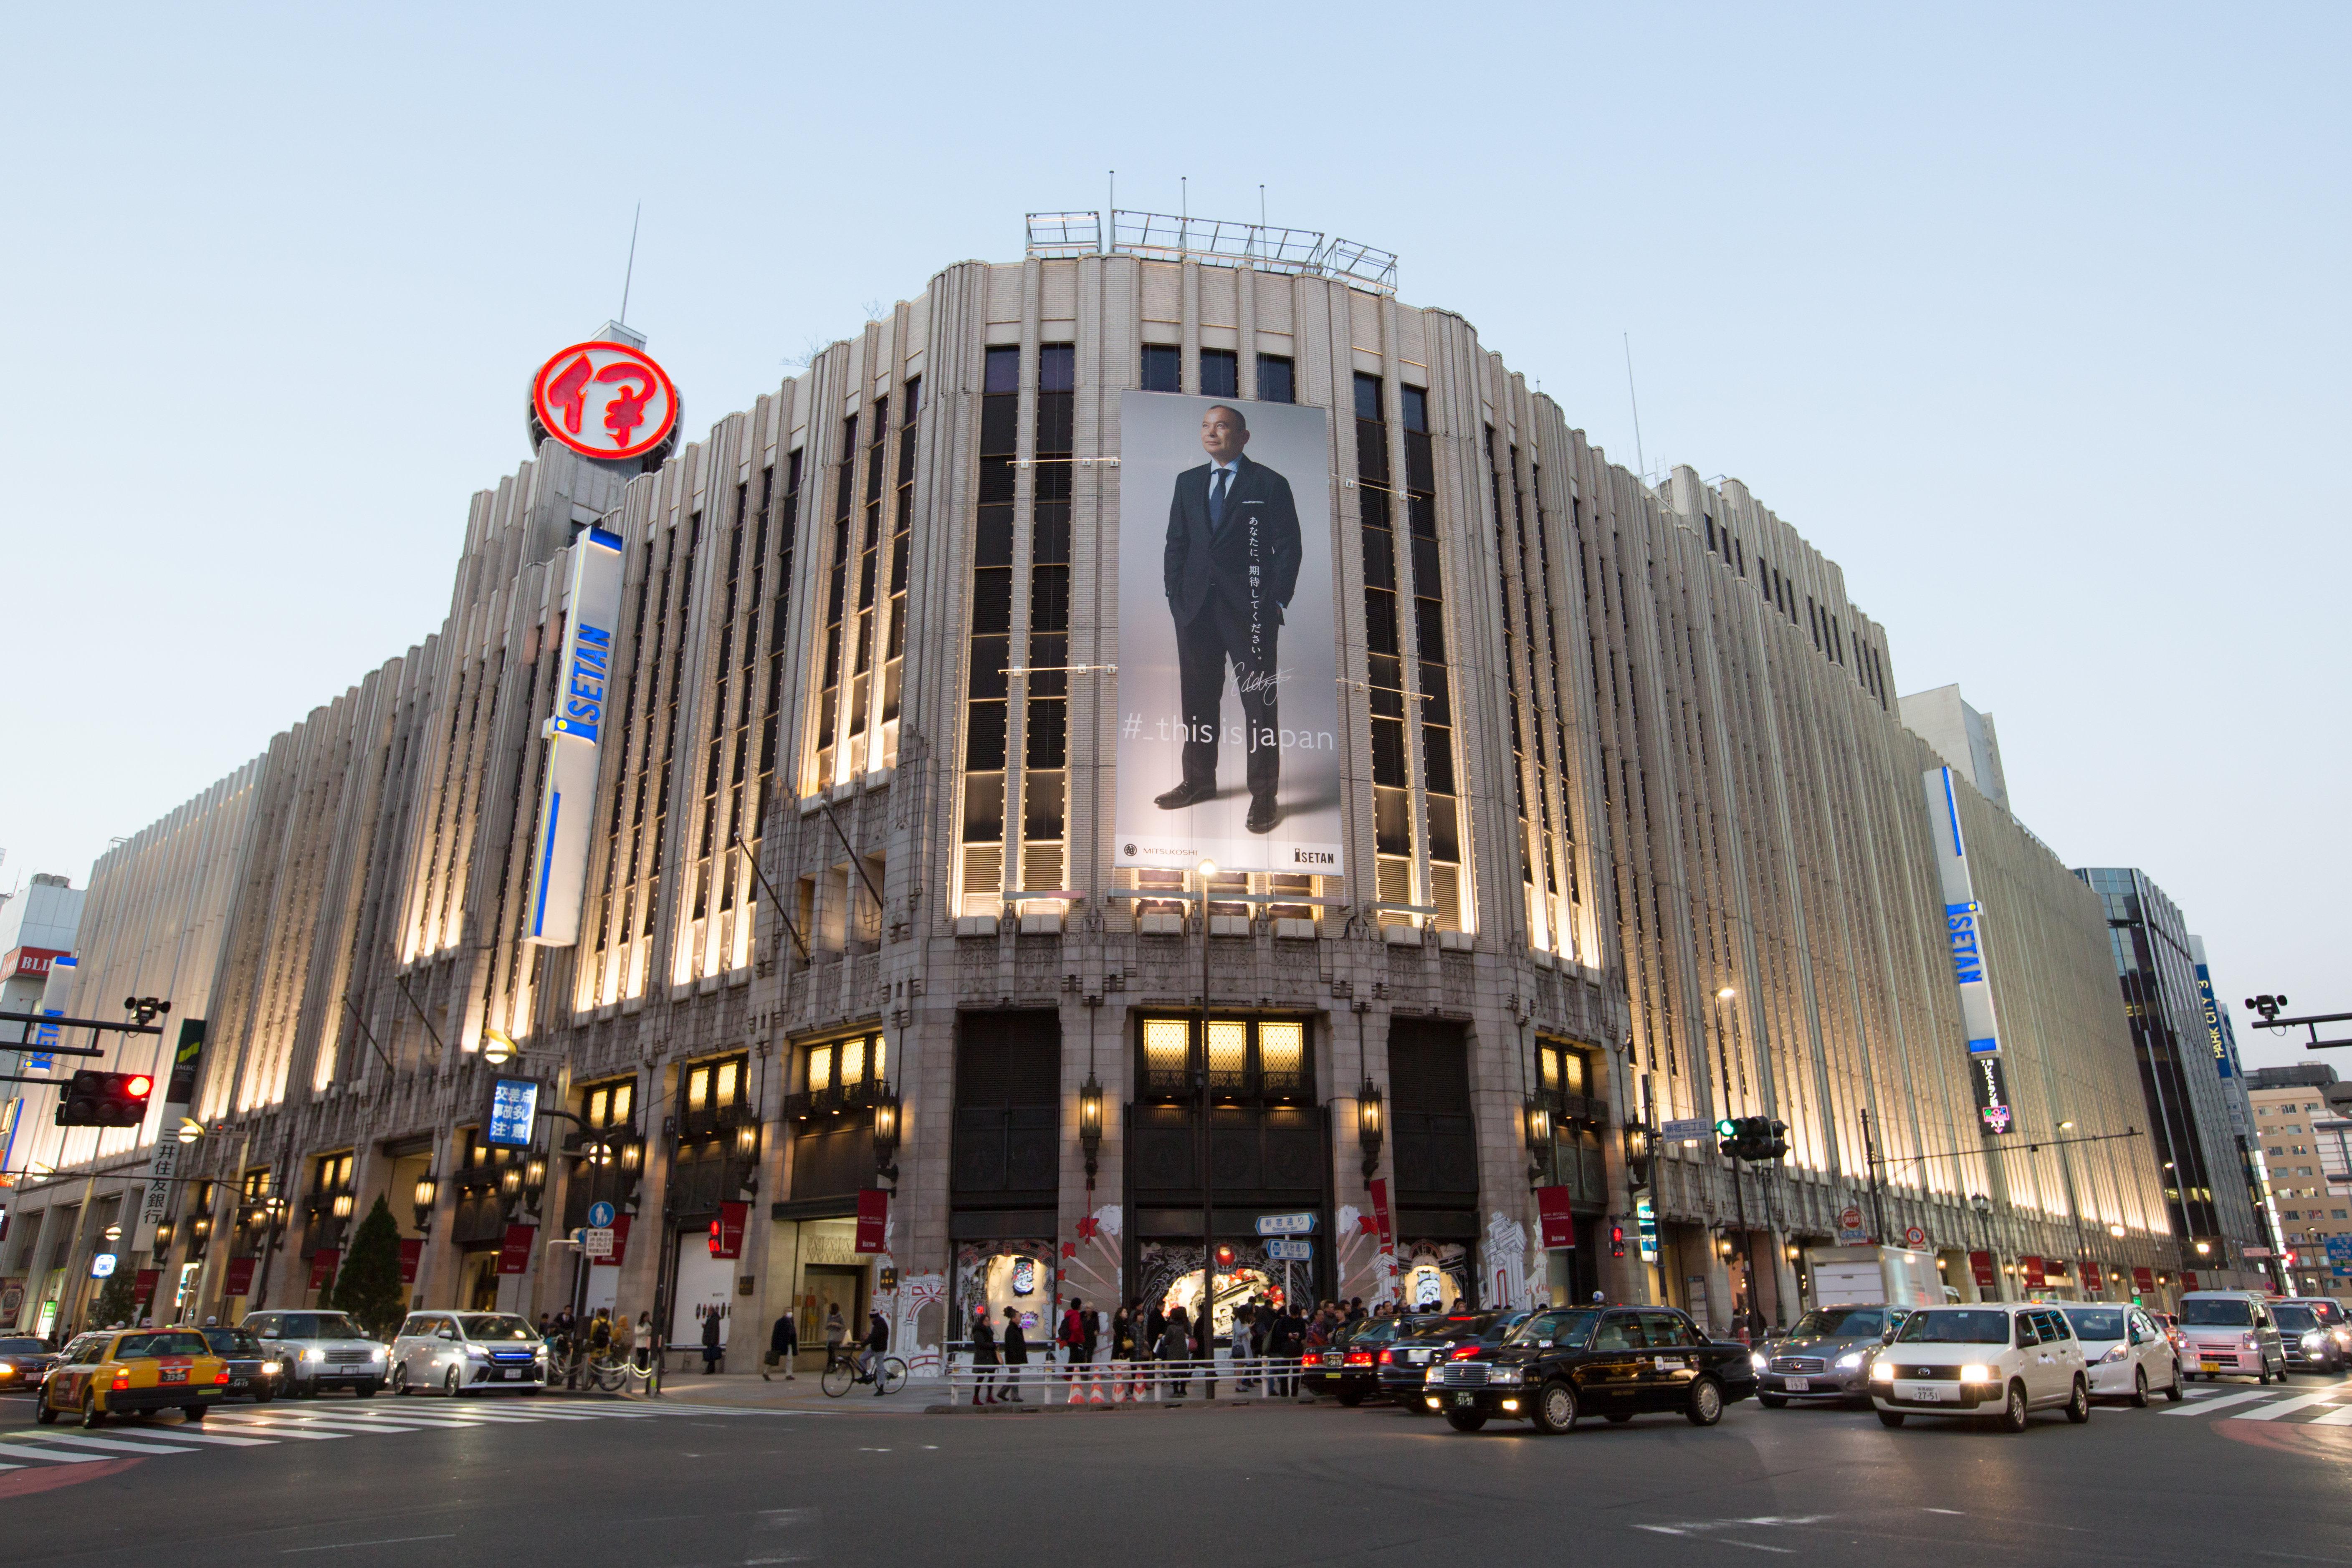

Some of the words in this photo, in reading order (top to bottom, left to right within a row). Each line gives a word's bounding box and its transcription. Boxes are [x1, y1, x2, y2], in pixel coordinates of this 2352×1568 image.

[1249, 516, 1262, 660] あなたに、期待してください。
[1223, 718, 1242, 745] is
[1250, 719, 1333, 755] japan
[1295, 848, 1334, 864] ISETAN
[2198, 979, 2209, 989] 3
[2209, 1026, 2226, 1059] PARK
[495, 1086, 534, 1103] 交差点
[491, 1121, 526, 1138] 注意
[1666, 1121, 1707, 1133] 新宿三丁目
[144, 1129, 180, 1224] 三井住友銀行
[1265, 1216, 1304, 1227] 新宿通り
[1283, 1242, 1307, 1252] 明治通り
[1918, 1391, 1938, 1400] 27-51
